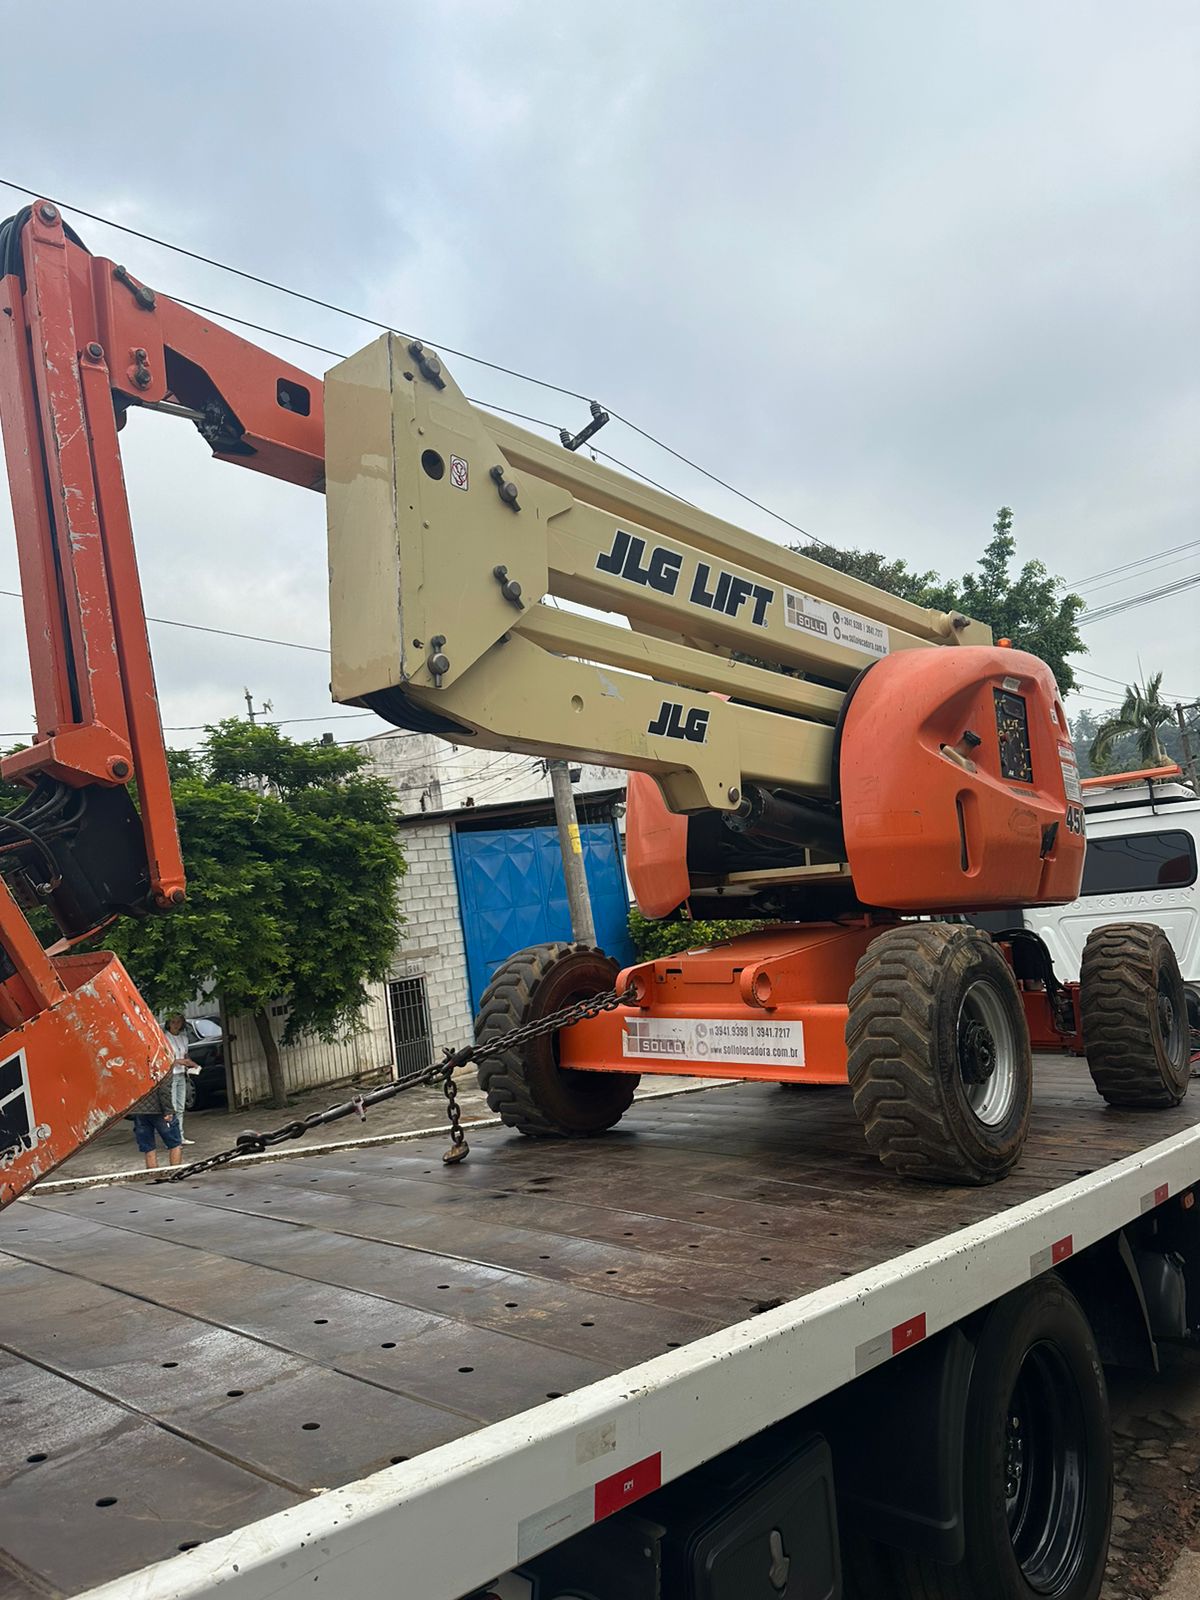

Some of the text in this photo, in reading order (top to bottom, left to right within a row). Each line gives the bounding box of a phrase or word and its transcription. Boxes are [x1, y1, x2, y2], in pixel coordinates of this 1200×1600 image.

[595, 530, 683, 596] JLG
[799, 615, 826, 634] SOLLO
[648, 702, 710, 743] JLG
[757, 1027, 791, 1038] 3941.7217
[643, 1041, 682, 1053] SOLLO
